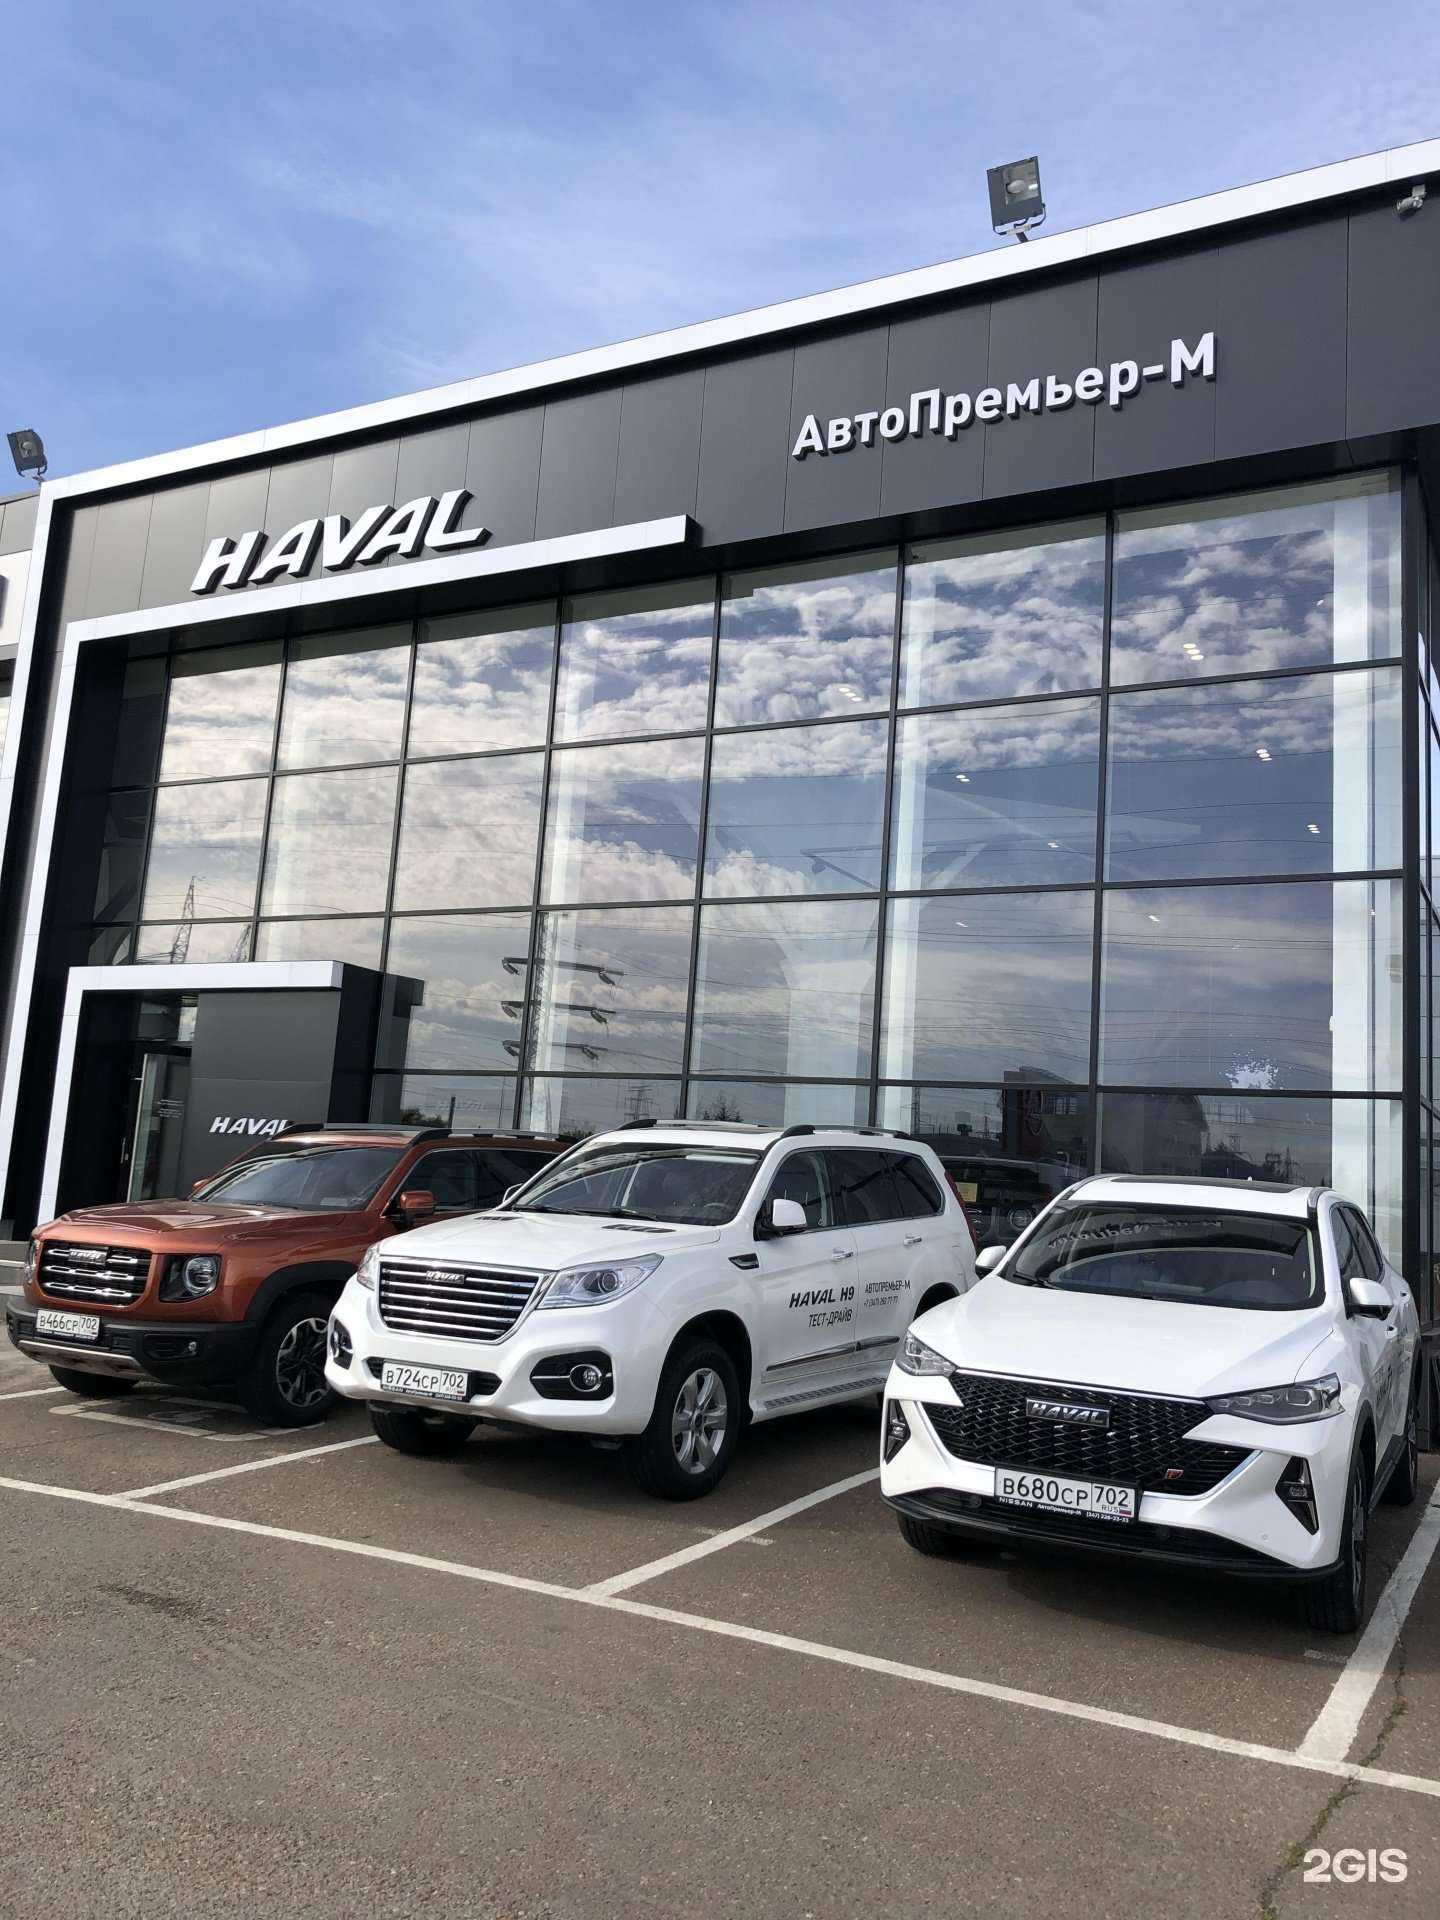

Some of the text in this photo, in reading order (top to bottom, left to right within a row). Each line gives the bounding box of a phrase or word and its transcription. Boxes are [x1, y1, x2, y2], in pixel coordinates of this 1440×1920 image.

[791, 331, 1216, 458] АвтоПремьер-М
[190, 488, 492, 594] HAVAL
[789, 1286, 855, 1308] HAVAL H9
[81, 1317, 97, 1329] 702
[809, 1307, 853, 1327] ТЕСТ-ДРАЙВ
[442, 1373, 464, 1388] 702
[1032, 1403, 1103, 1424] HAVAL
[1000, 1497, 1033, 1508] NISSAN
[1094, 1486, 1128, 1507] 702
